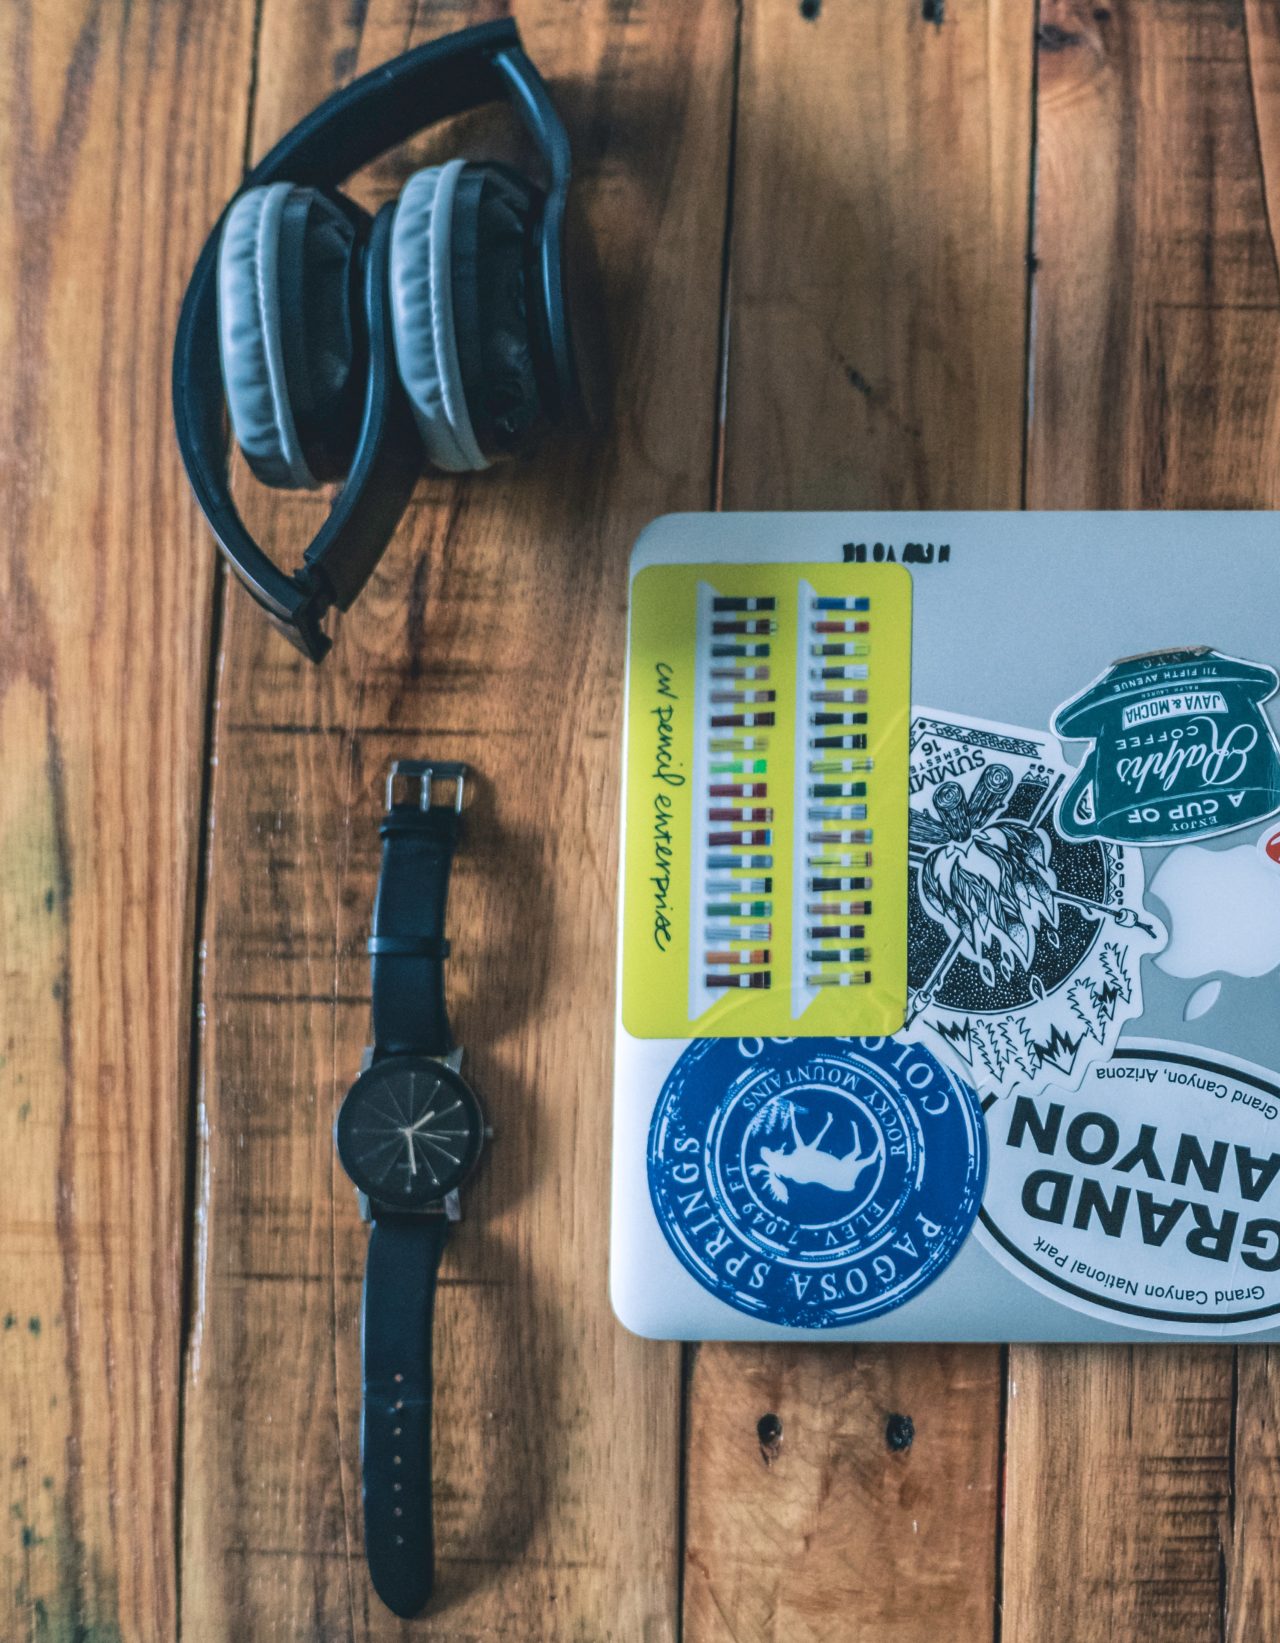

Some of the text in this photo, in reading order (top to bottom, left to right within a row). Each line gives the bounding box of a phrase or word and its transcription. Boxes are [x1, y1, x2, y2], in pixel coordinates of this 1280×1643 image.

[1113, 667, 1217, 692] 711 FIFTH AVENUE
[1141, 685, 1199, 698] RALPH LAUREN
[1125, 694, 1221, 724] JAVA & MOCHA
[650, 704, 686, 786] pencil
[921, 739, 941, 756] 16
[1115, 725, 1199, 750] COFFEE
[1116, 715, 1258, 794] Ralph's
[908, 749, 986, 796] SUMM
[1127, 791, 1246, 824] A CUP OF
[1169, 815, 1218, 832] ENJOY
[650, 793, 674, 952] enterprise
[738, 1036, 949, 1115] COLOO
[1095, 1067, 1279, 1121] Grand Canyon, Arizona
[742, 1065, 905, 1156] ROCKY MOUNTAINS
[673, 1137, 942, 1301] PAGOSA SPRINGS
[814, 1200, 885, 1246] ELEV.
[1032, 1235, 1265, 1306] Grand Canyon National Park
